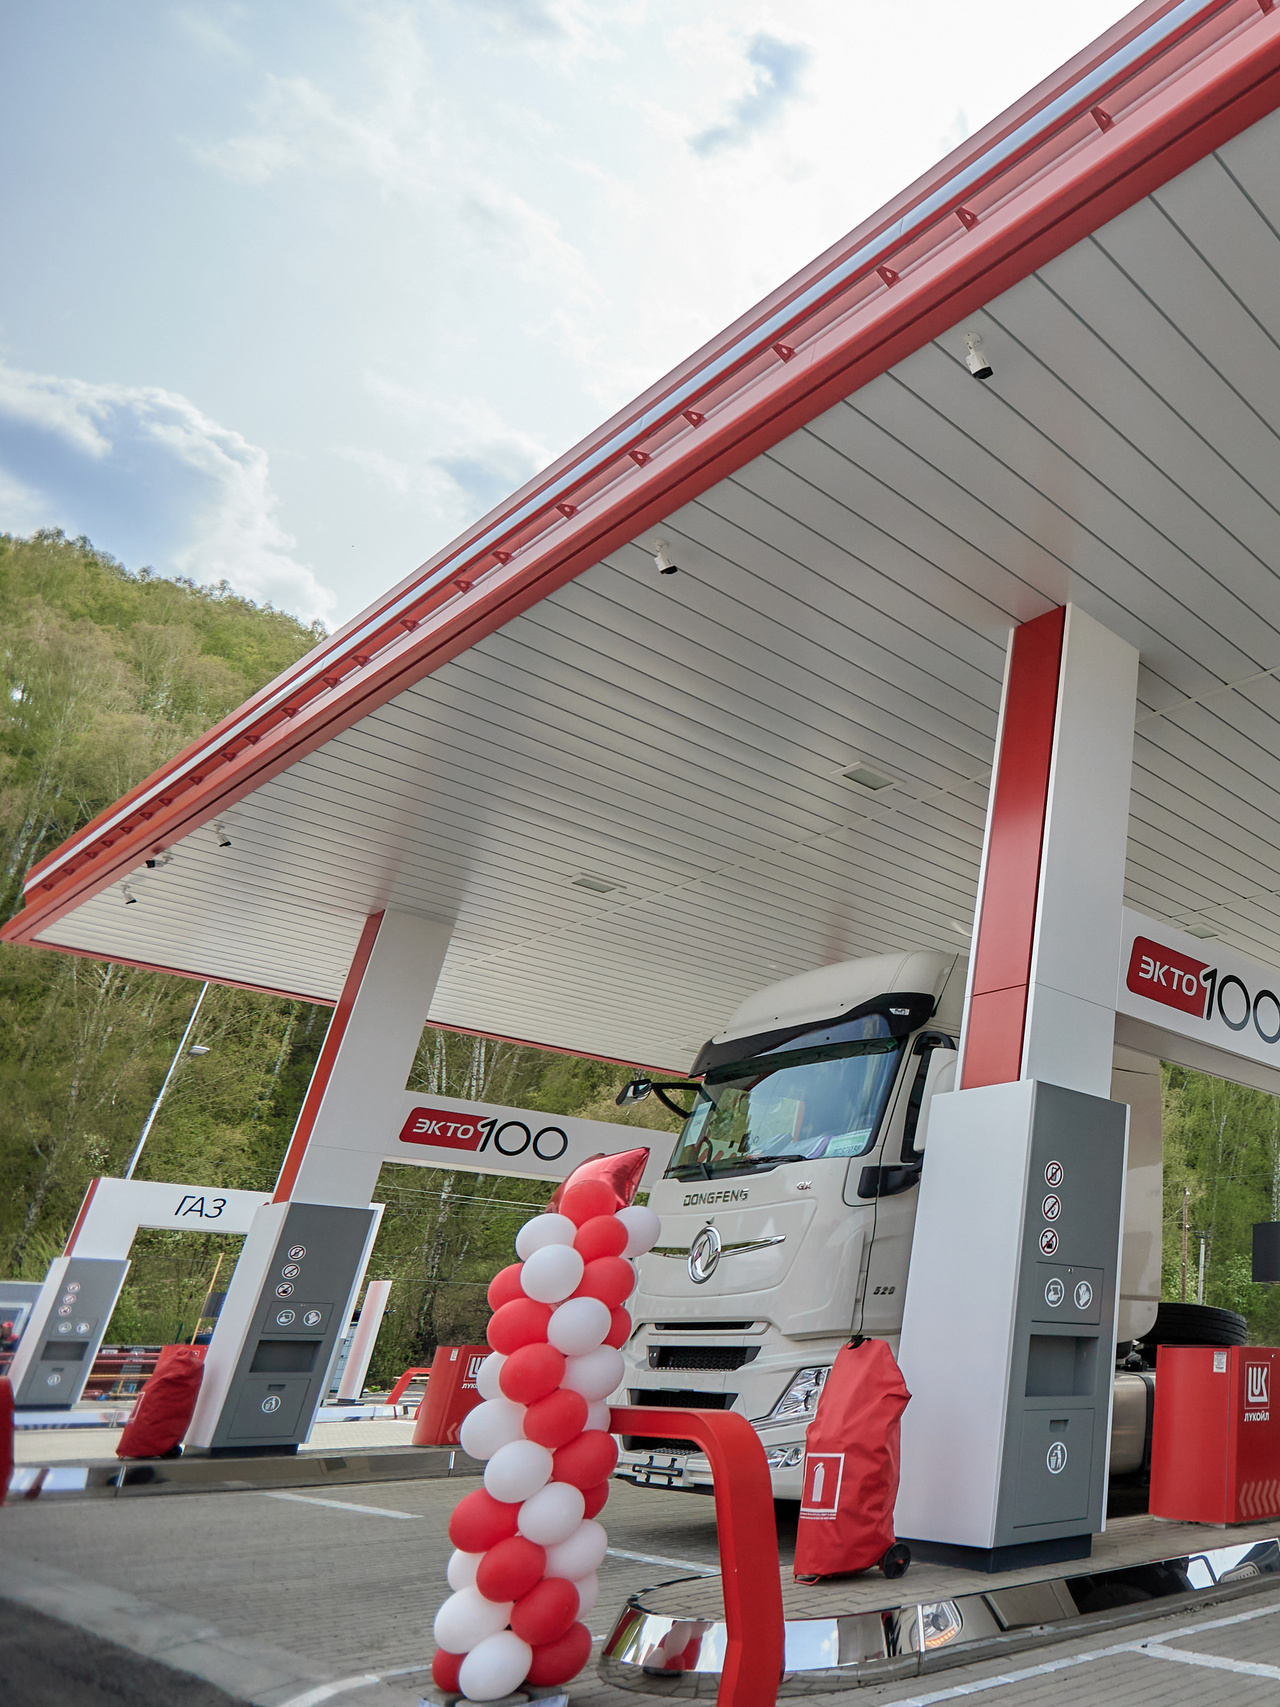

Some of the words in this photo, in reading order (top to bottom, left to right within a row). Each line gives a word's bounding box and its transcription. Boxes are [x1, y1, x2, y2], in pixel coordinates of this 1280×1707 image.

[1138, 955, 1198, 996] ЭКТО
[412, 1118, 475, 1139] ЭКТО
[478, 1118, 568, 1161] 100
[174, 1195, 227, 1218] ГАЗ
[683, 1188, 750, 1206] DONGFENG
[873, 1286, 896, 1295] 520
[1244, 1411, 1270, 1422] ЛУКОЙЛ
